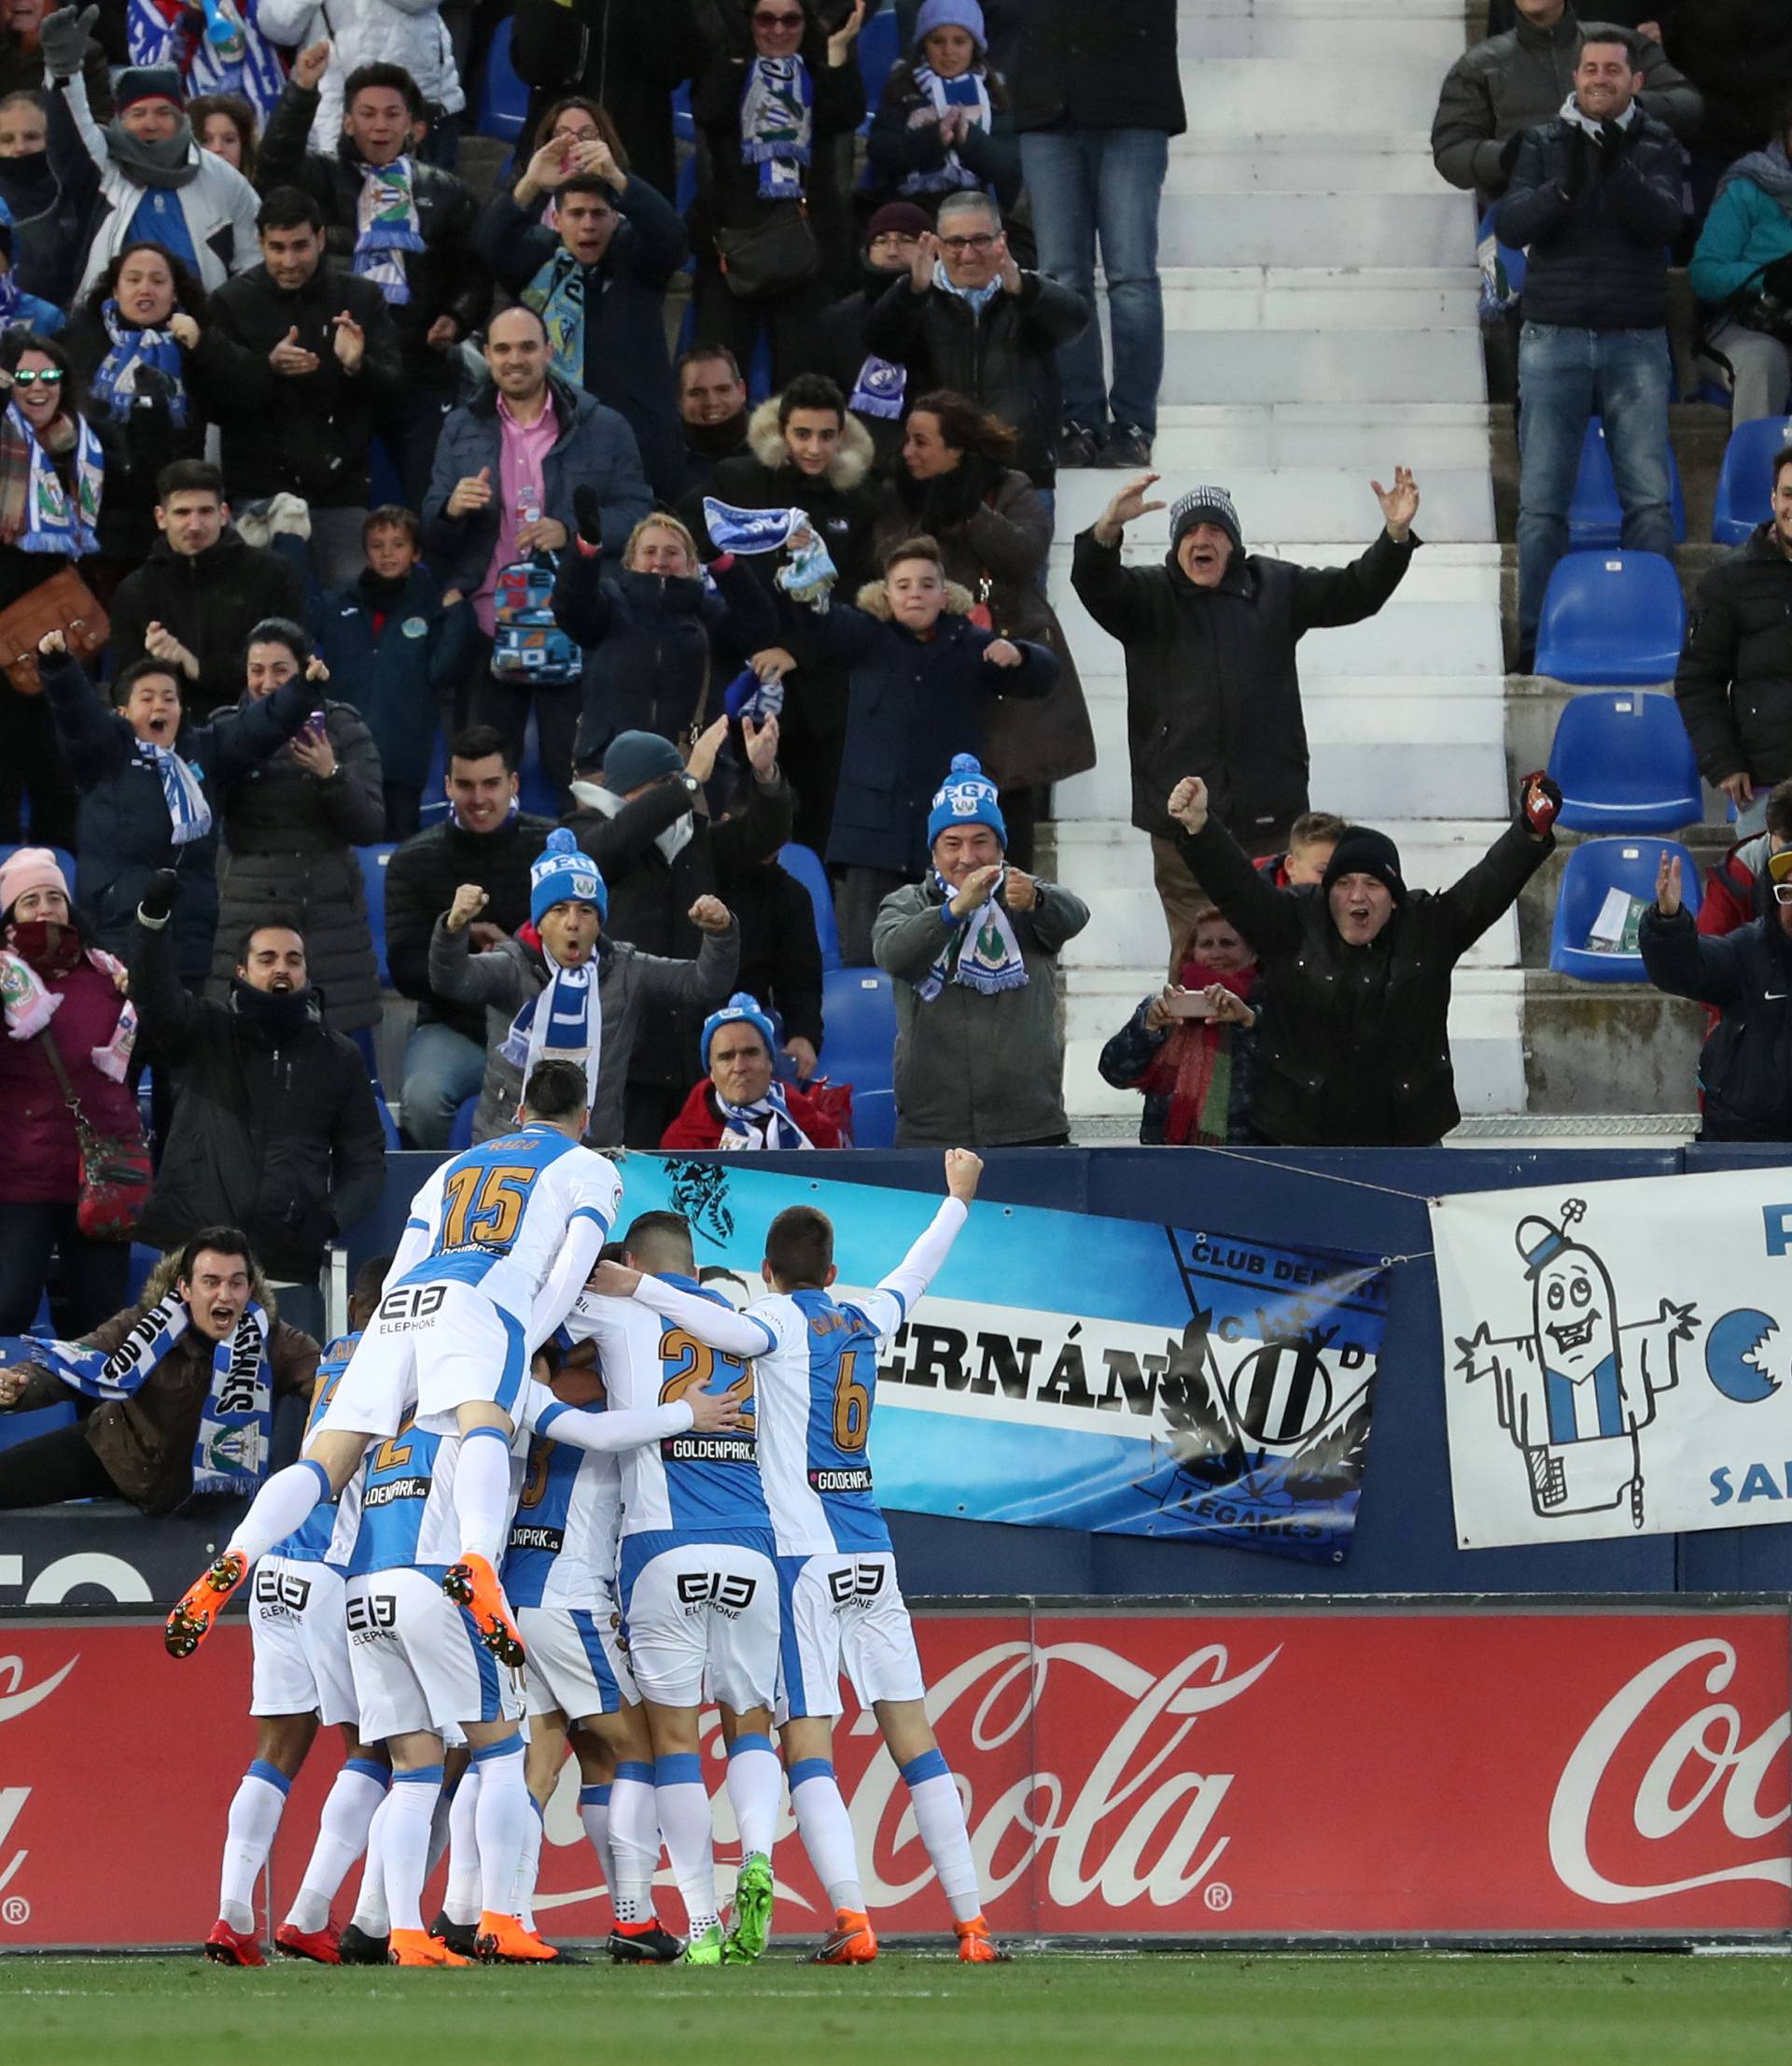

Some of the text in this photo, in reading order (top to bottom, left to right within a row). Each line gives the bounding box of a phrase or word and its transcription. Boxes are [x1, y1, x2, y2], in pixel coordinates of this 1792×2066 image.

[935, 784, 995, 805] EGA
[442, 1166, 538, 1247] 15
[1192, 1242, 1266, 1275] CLUB
[379, 1317, 436, 1335] ELEPHONE
[877, 1321, 1168, 1417] ERNÁN
[833, 1350, 869, 1453] 6
